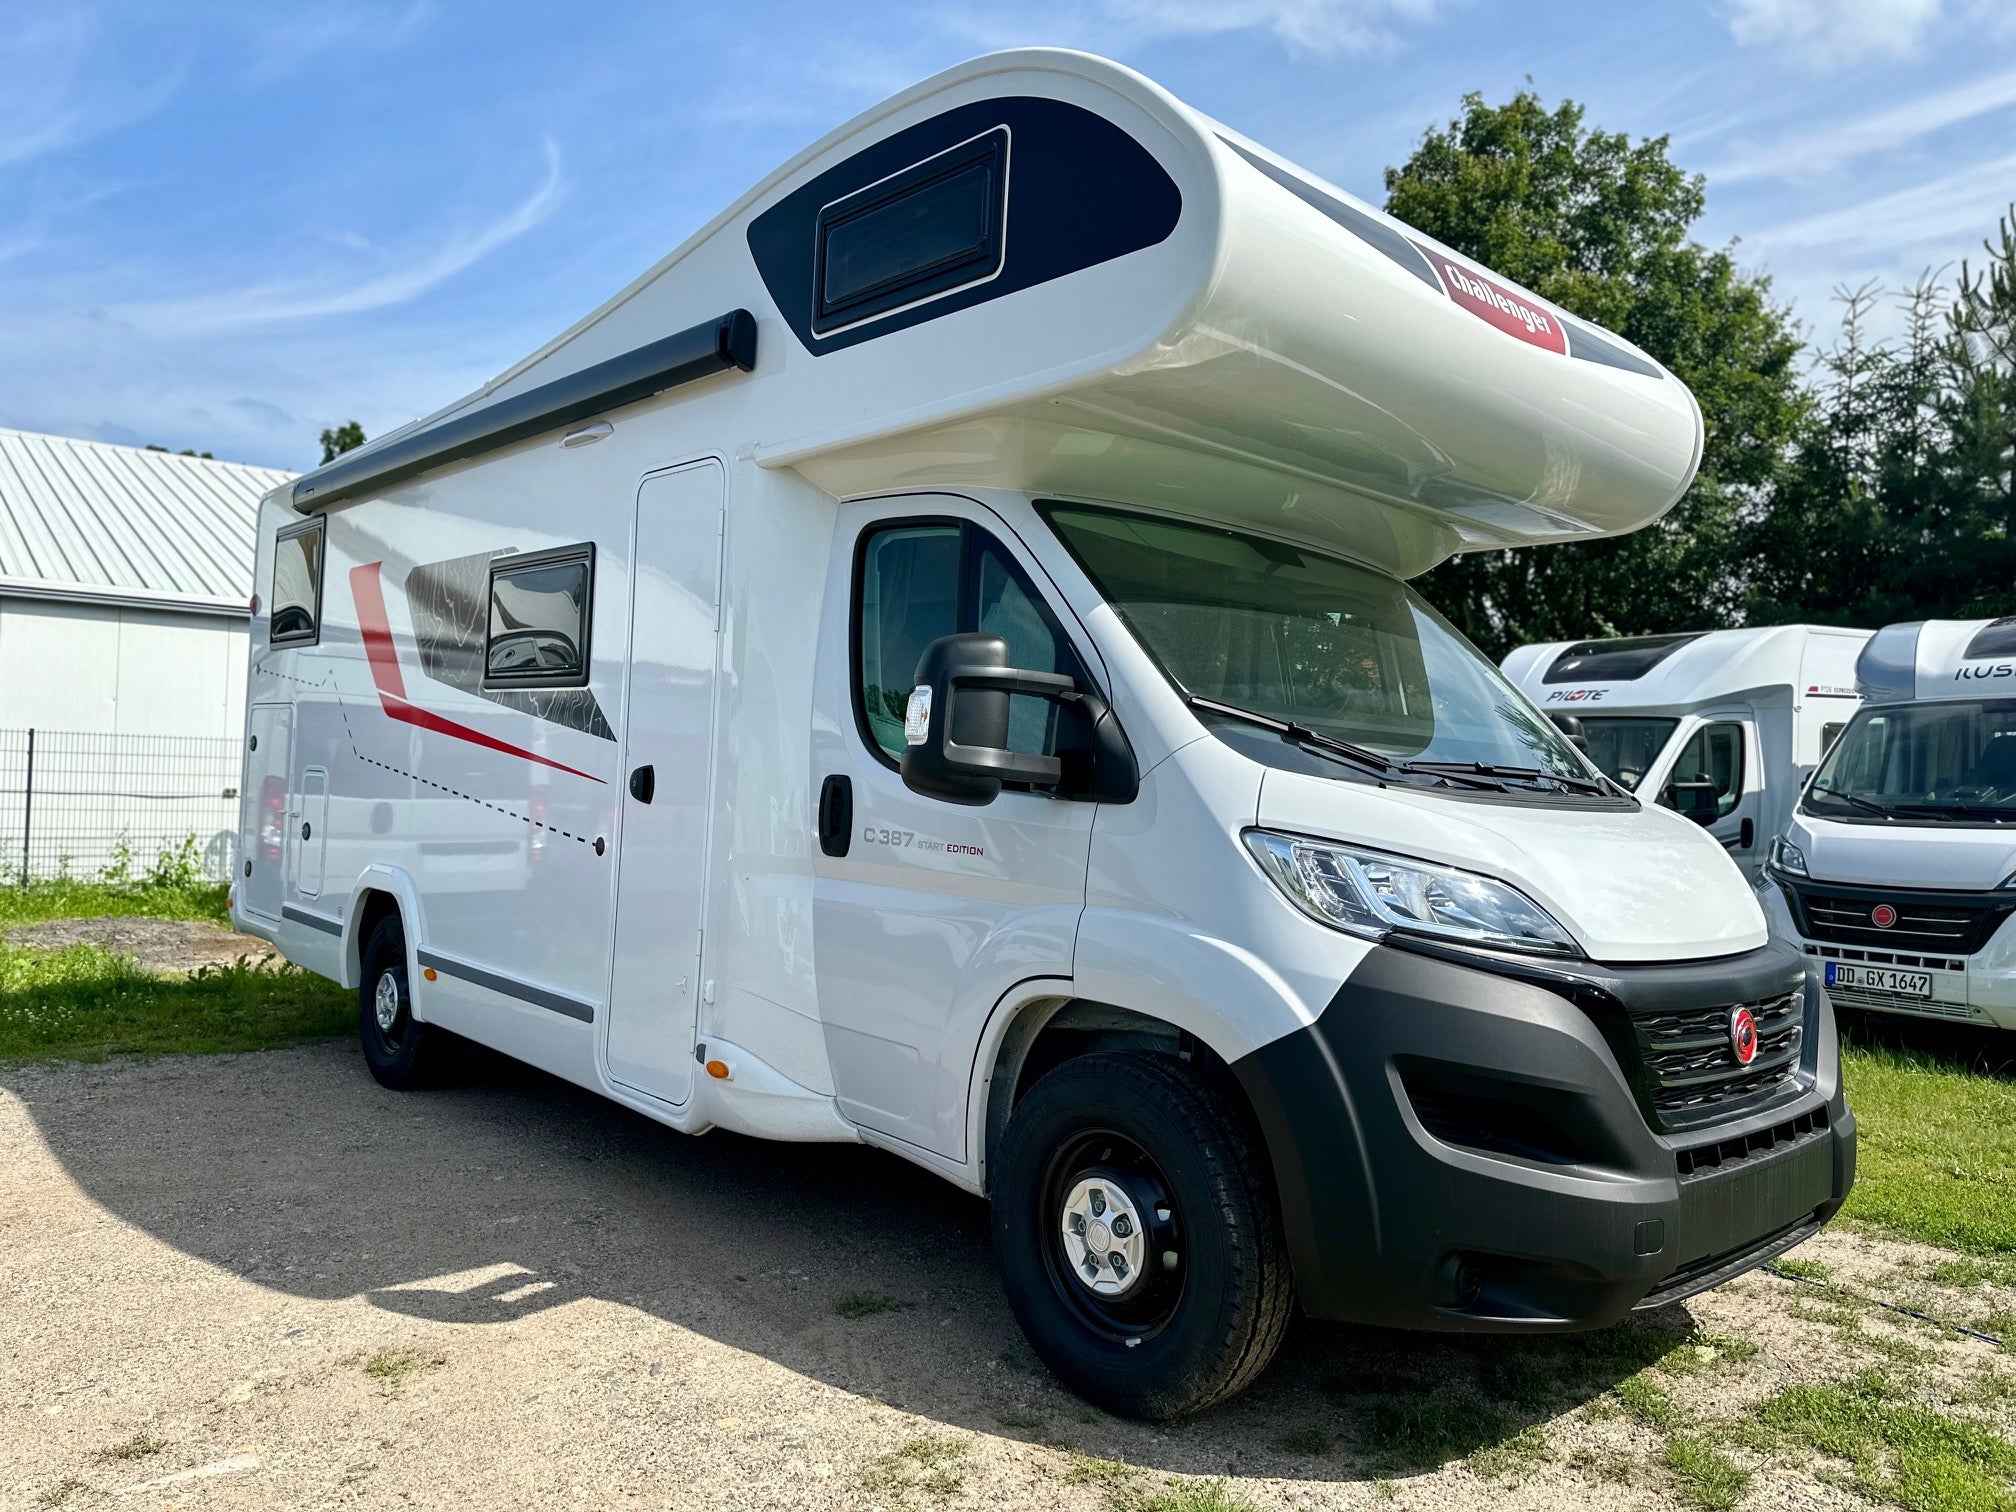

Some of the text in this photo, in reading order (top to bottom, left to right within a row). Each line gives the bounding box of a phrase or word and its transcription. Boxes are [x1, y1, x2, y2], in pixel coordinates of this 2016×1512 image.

[1444, 264, 1552, 334] Challenger
[1954, 664, 2016, 681] ILUS
[1545, 689, 1610, 702] PILOTE
[879, 829, 915, 848] 387
[918, 841, 944, 852] START
[946, 844, 984, 856] EDITION
[1837, 966, 1855, 984] DD
[1866, 970, 1885, 988] GX
[1889, 973, 1928, 992] 1647
